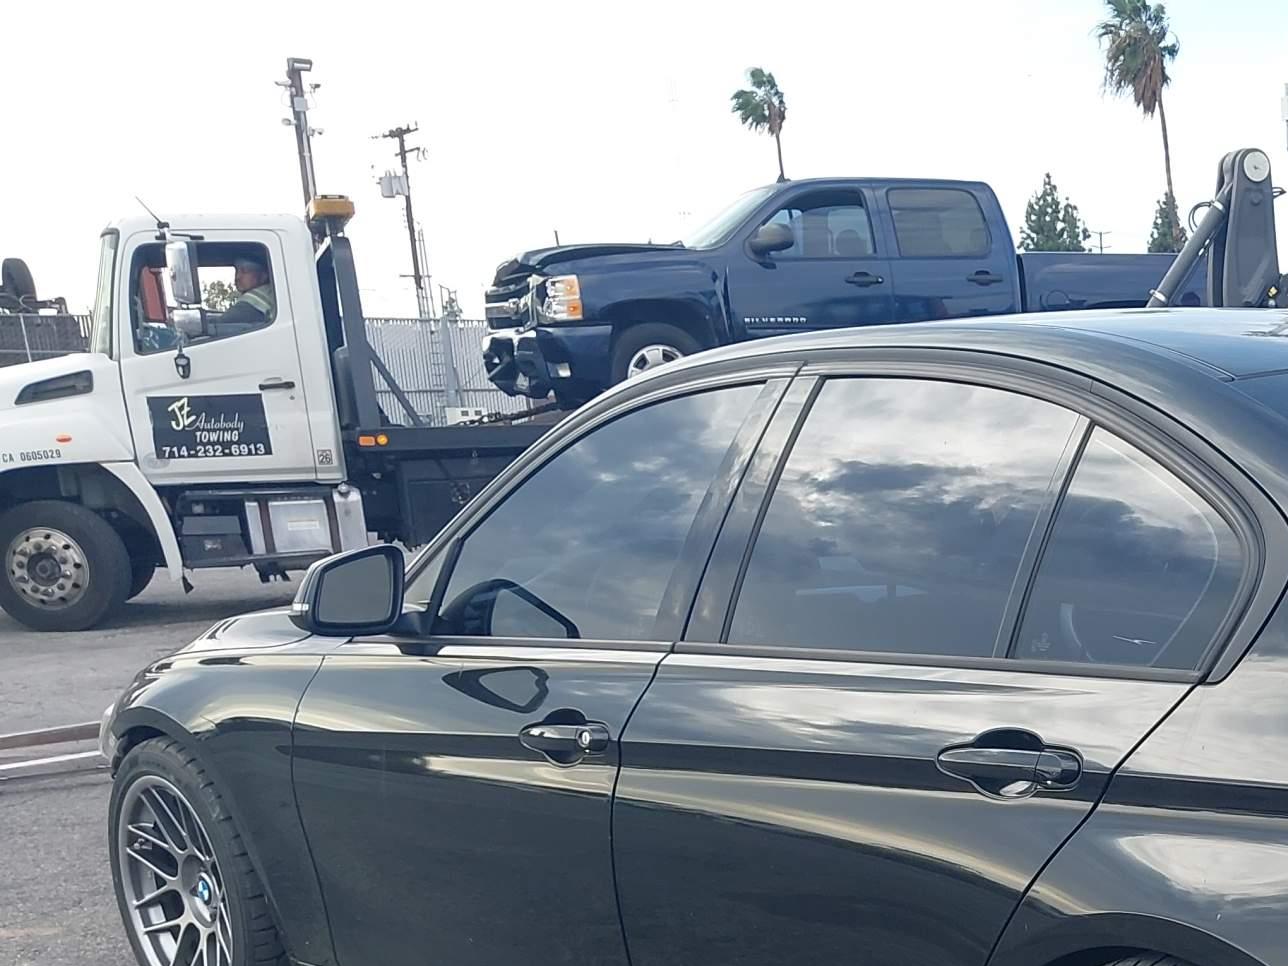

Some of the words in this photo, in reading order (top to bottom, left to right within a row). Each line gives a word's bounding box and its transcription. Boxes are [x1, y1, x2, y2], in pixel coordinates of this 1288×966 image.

[185, 412, 244, 433] Autobody
[195, 430, 239, 443] TOWING
[2, 453, 14, 463] CA
[20, 449, 61, 462] 0605029
[162, 443, 265, 458] 714-232-6913
[319, 453, 332, 464] 26
